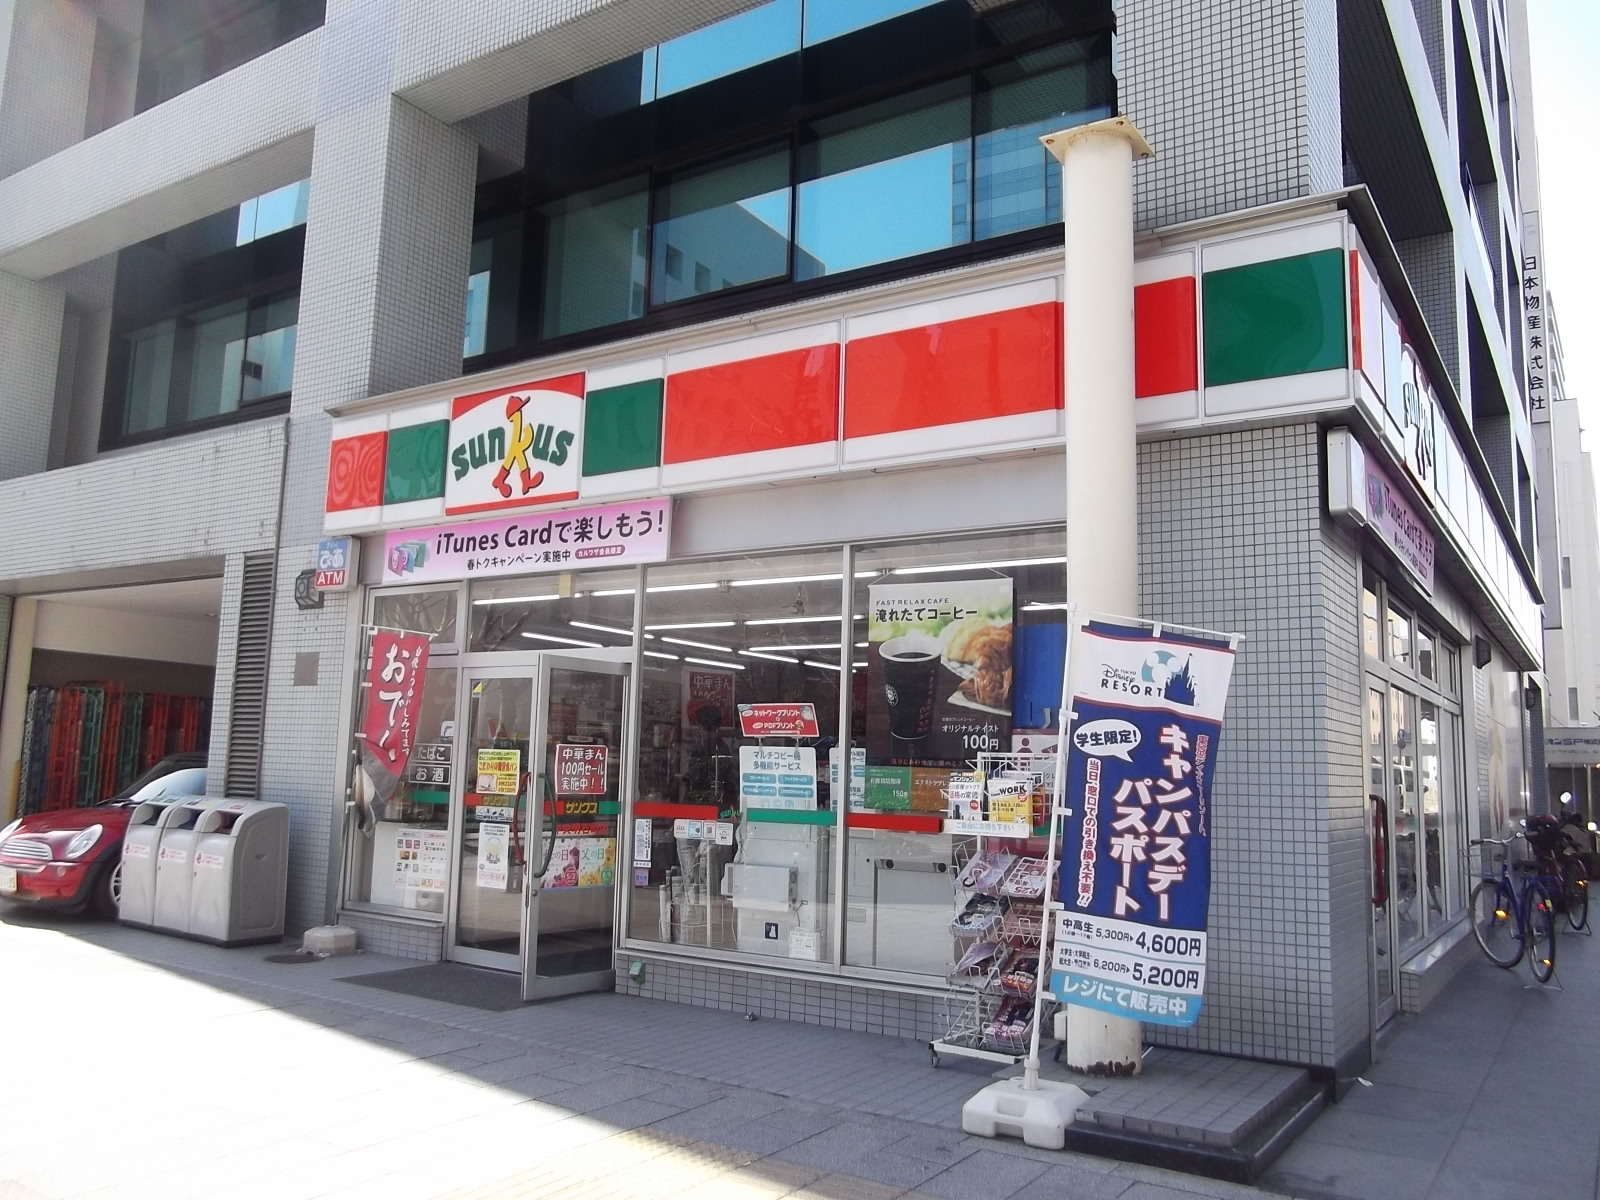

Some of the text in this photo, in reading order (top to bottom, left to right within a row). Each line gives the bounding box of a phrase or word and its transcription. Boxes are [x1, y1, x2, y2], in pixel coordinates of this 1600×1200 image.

[1523, 256, 1546, 411] 日本物産株式会社
[436, 509, 664, 555] iTunes Cardで楽しもう!
[466, 549, 572, 571] 春トクキャンペーン実施中
[317, 570, 344, 586] ATM
[926, 597, 950, 605] CAFE
[875, 606, 978, 623] 淹れたてコーヒー
[1101, 678, 1163, 698] RESORT
[942, 723, 1000, 734] オリジナルテイスト
[962, 734, 1000, 751] 100円
[1075, 729, 1139, 748] 学生限定!
[416, 746, 447, 762] たばこ
[562, 747, 605, 761] 中華まん
[752, 751, 802, 761] マルチコピー機
[560, 761, 606, 777] 100円セール
[752, 761, 803, 771] 多機能サービス
[415, 767, 445, 783] お酒
[1000, 784, 1028, 796] WORK
[565, 801, 598, 814] サンクス
[1148, 724, 1193, 922] キャンパスデー
[1110, 778, 1153, 917] パスポート
[1062, 918, 1094, 934] 中高生
[1095, 927, 1130, 942] 5,300円
[1135, 931, 1201, 957] 4,600円
[1093, 958, 1127, 974] 6,200円
[1132, 962, 1200, 990] 5,200円
[1062, 975, 1189, 1017] レジにて販売中
